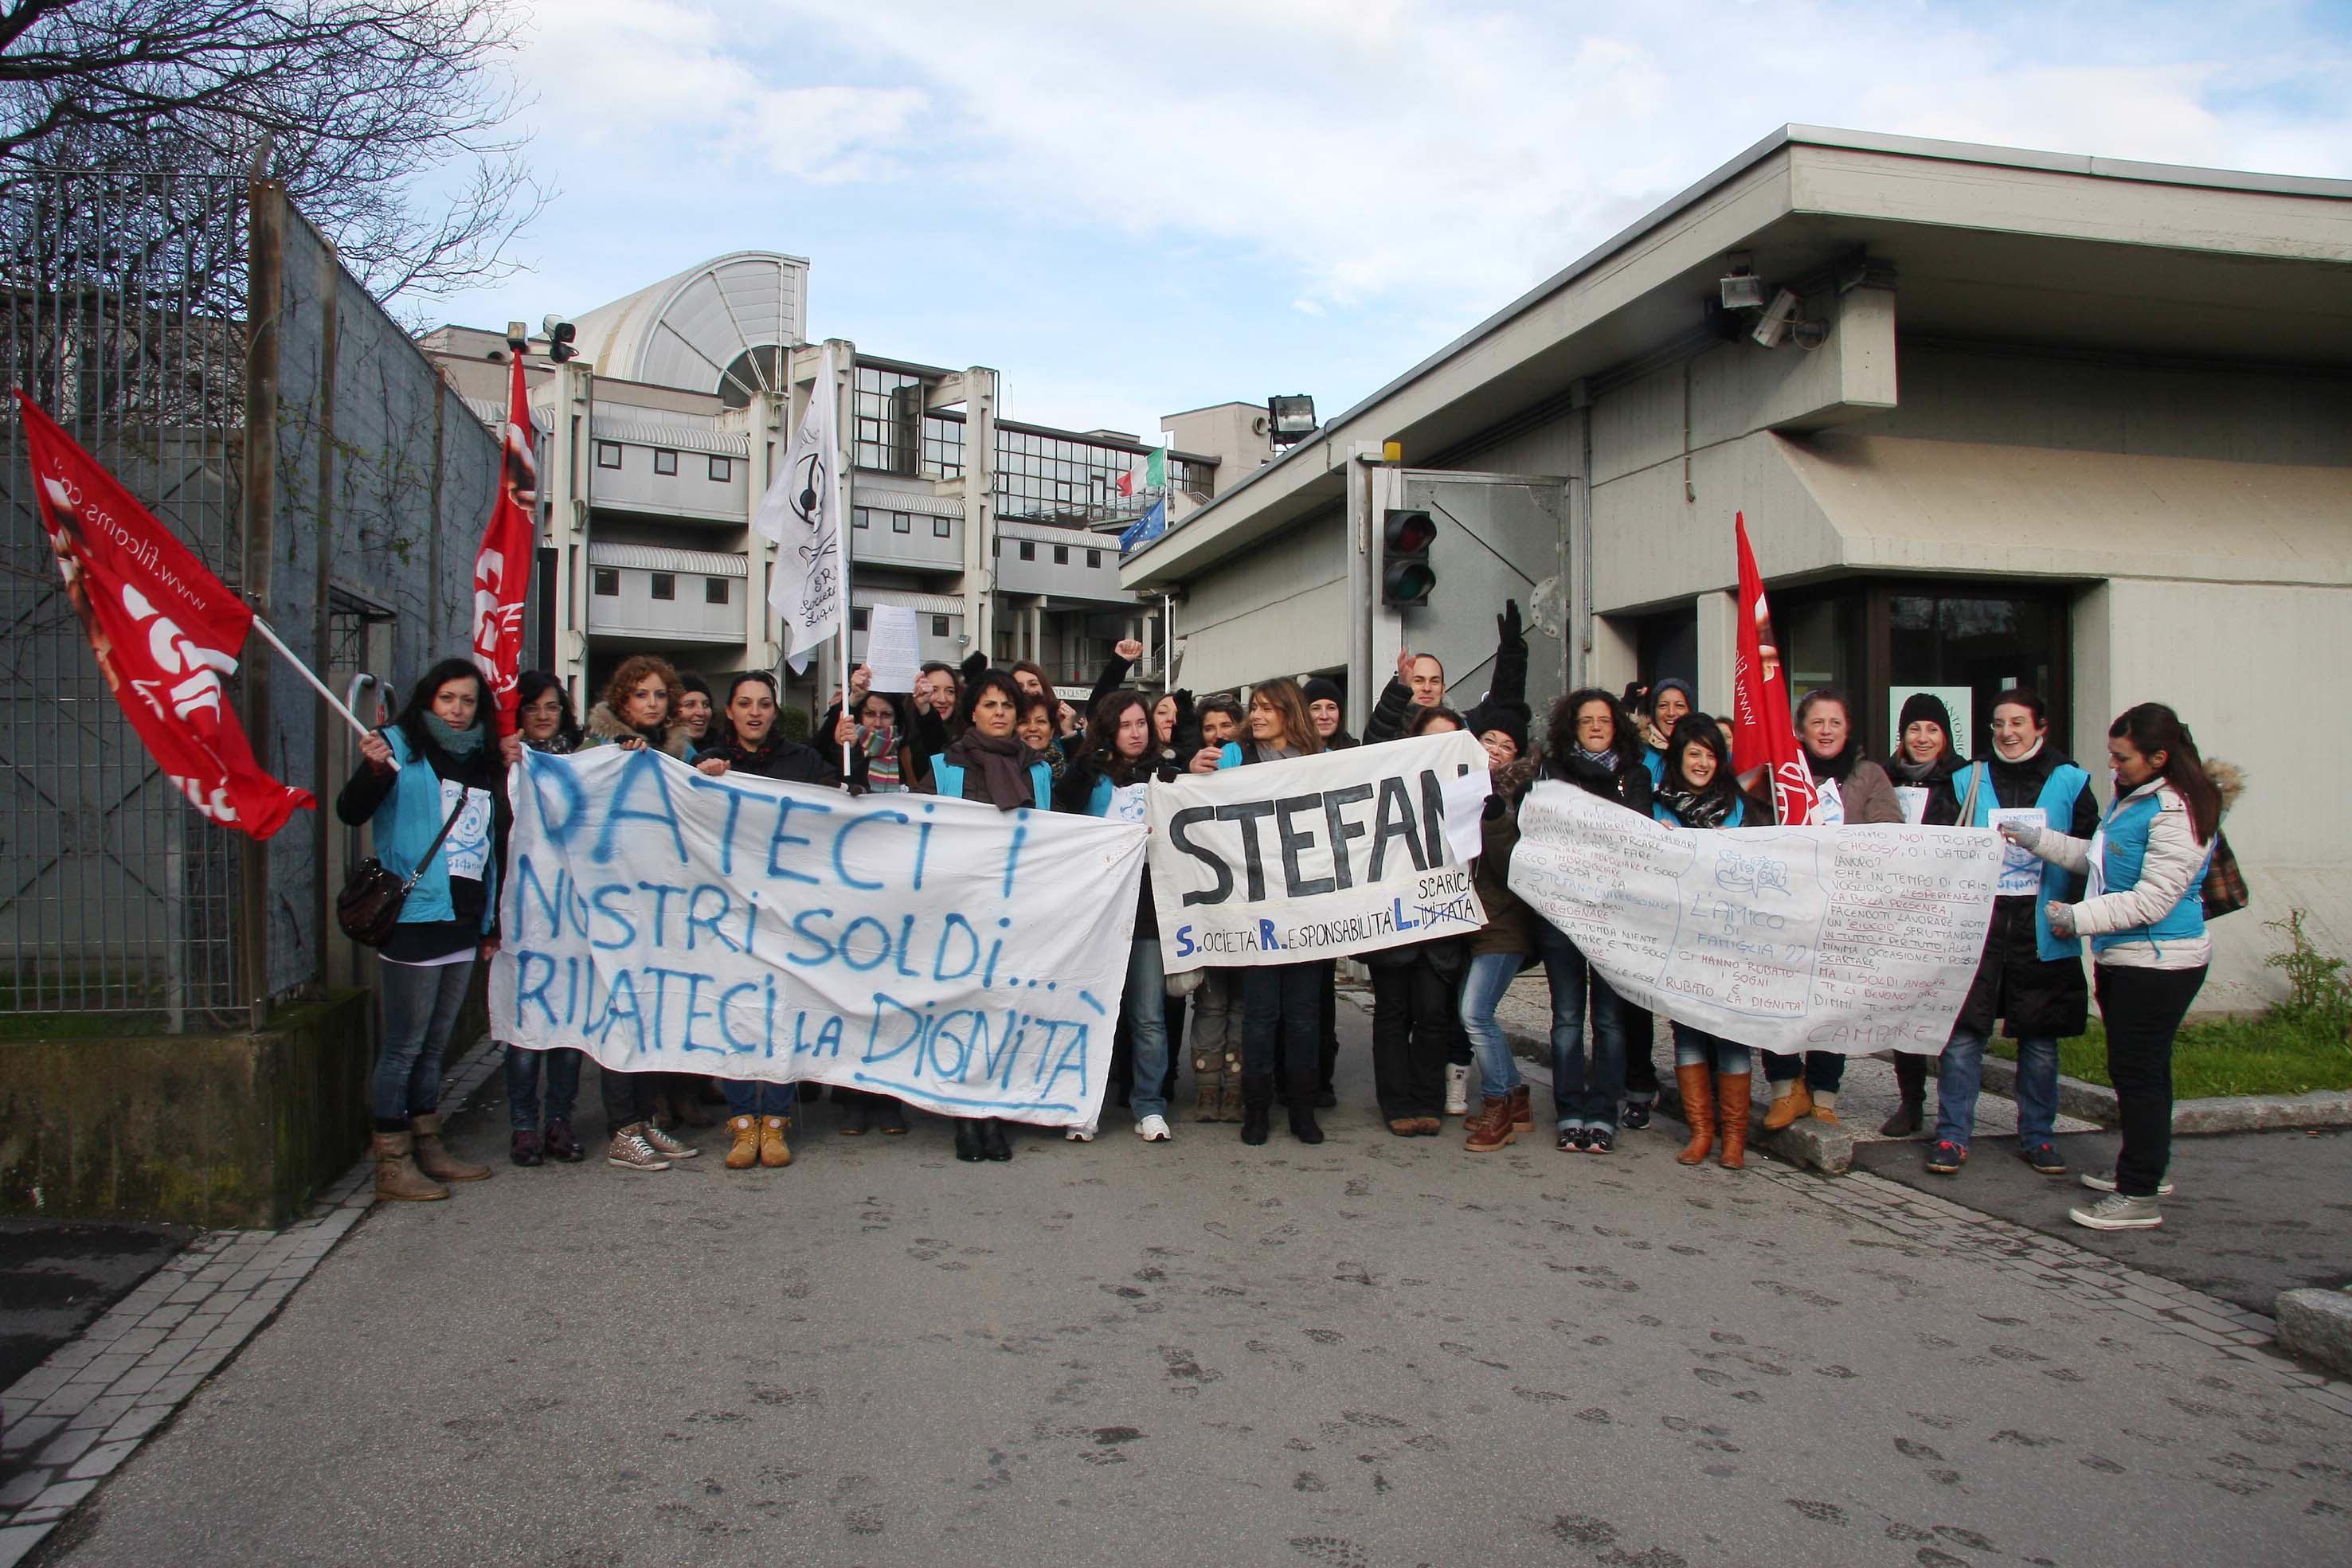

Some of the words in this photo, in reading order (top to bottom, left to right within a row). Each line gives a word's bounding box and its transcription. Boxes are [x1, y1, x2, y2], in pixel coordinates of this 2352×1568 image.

[528, 749, 933, 891] DATECI
[1002, 807, 1028, 899] I
[1837, 829, 1888, 840] SIAMO
[1899, 833, 1925, 843] NOI
[1930, 835, 1994, 848] TROPPO
[1935, 847, 1981, 861] DATORI
[1832, 879, 1893, 893] VOGLIONO
[1872, 872, 1884, 882] IN
[1887, 873, 1934, 887] TEMPO
[1939, 878, 1951, 888] DI
[1830, 892, 1846, 902] LA
[1851, 894, 1884, 906] BELLA
[1827, 917, 1842, 928] UN
[1830, 904, 1891, 921] FACENDOTI
[1897, 913, 1954, 929] LAVORARE
[1825, 930, 1835, 939] IN
[1837, 933, 1875, 943] TUTTO
[1701, 957, 1739, 969] HANNO
[1867, 948, 1929, 963] OCCASIONE
[1733, 972, 1769, 987] SOGNI
[1819, 967, 1836, 979] MA
[1858, 974, 1899, 987] SOLDI
[1666, 976, 1715, 997] RUBATO
[1726, 994, 1742, 1005] LA
[1820, 981, 1836, 991] TE
[1814, 993, 1852, 1010] DIMMI
[794, 1010, 844, 1058] LA
[1806, 1022, 1931, 1045] CAMPARE
